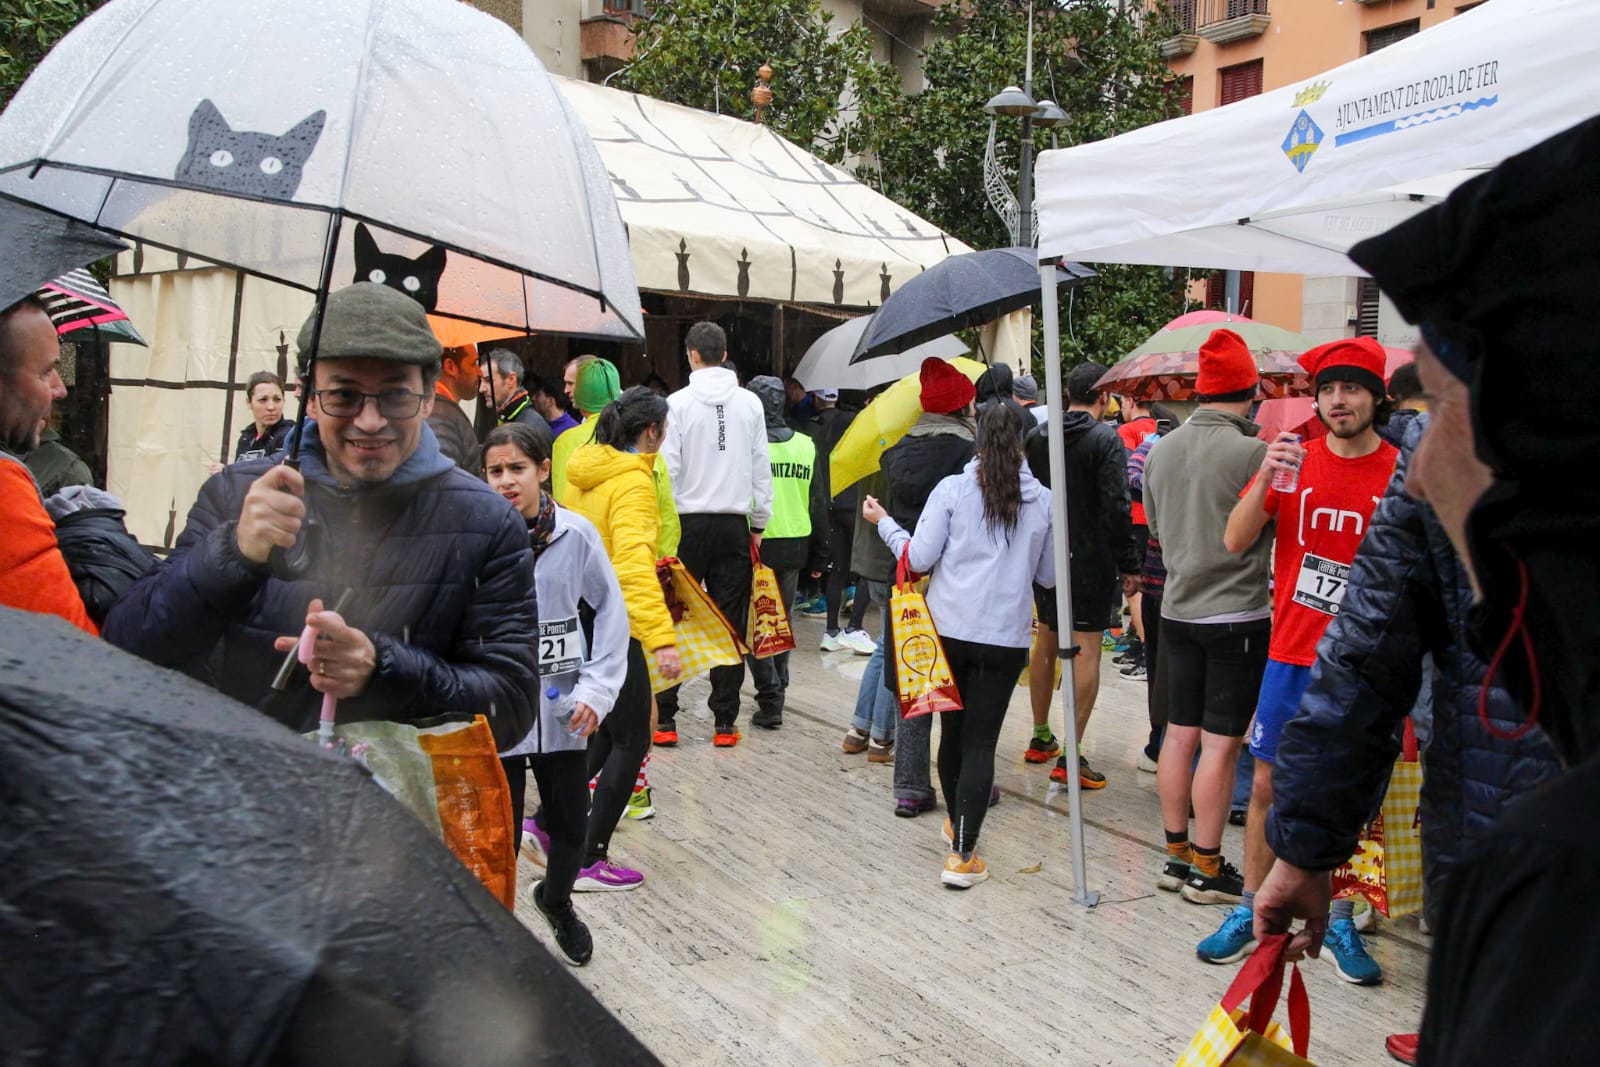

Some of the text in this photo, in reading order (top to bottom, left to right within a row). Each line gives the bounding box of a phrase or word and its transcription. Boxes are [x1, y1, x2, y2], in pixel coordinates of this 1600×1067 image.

[1336, 60, 1499, 130] AJUNTAMENT DE RODA DE TER
[1316, 575, 1347, 598] 17
[541, 638, 566, 660] 21
